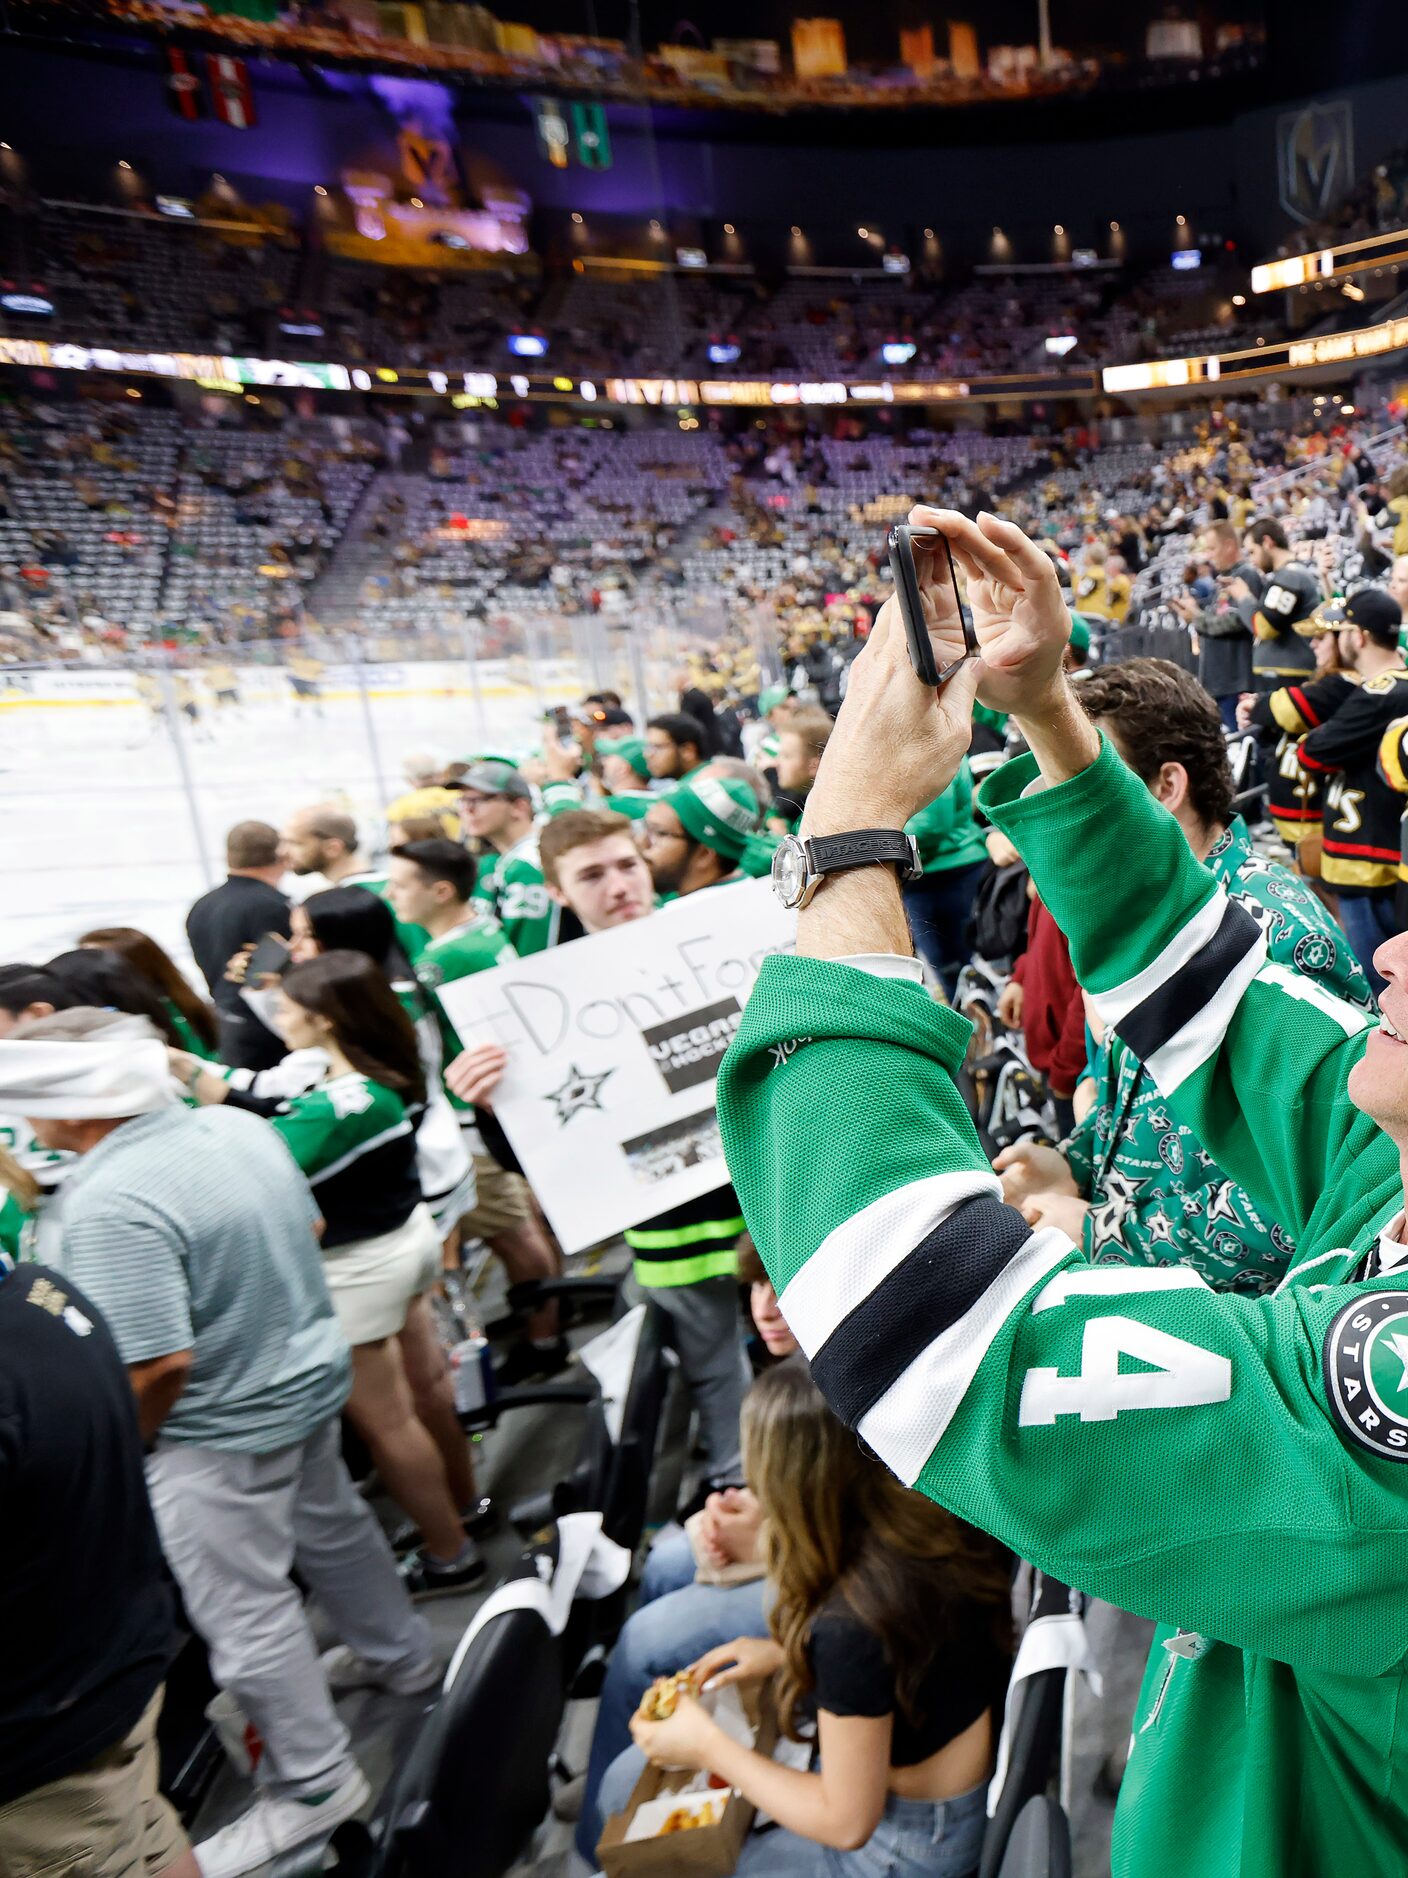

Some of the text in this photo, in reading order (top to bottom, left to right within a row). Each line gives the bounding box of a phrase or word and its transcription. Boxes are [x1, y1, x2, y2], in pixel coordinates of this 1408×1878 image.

[1131, 1089, 1163, 1109] STAR
[1114, 1154, 1163, 1170] STARS
[1175, 1227, 1239, 1269] STARS
[1018, 1266, 1232, 1428] 14
[1341, 1312, 1408, 1449] STARS
